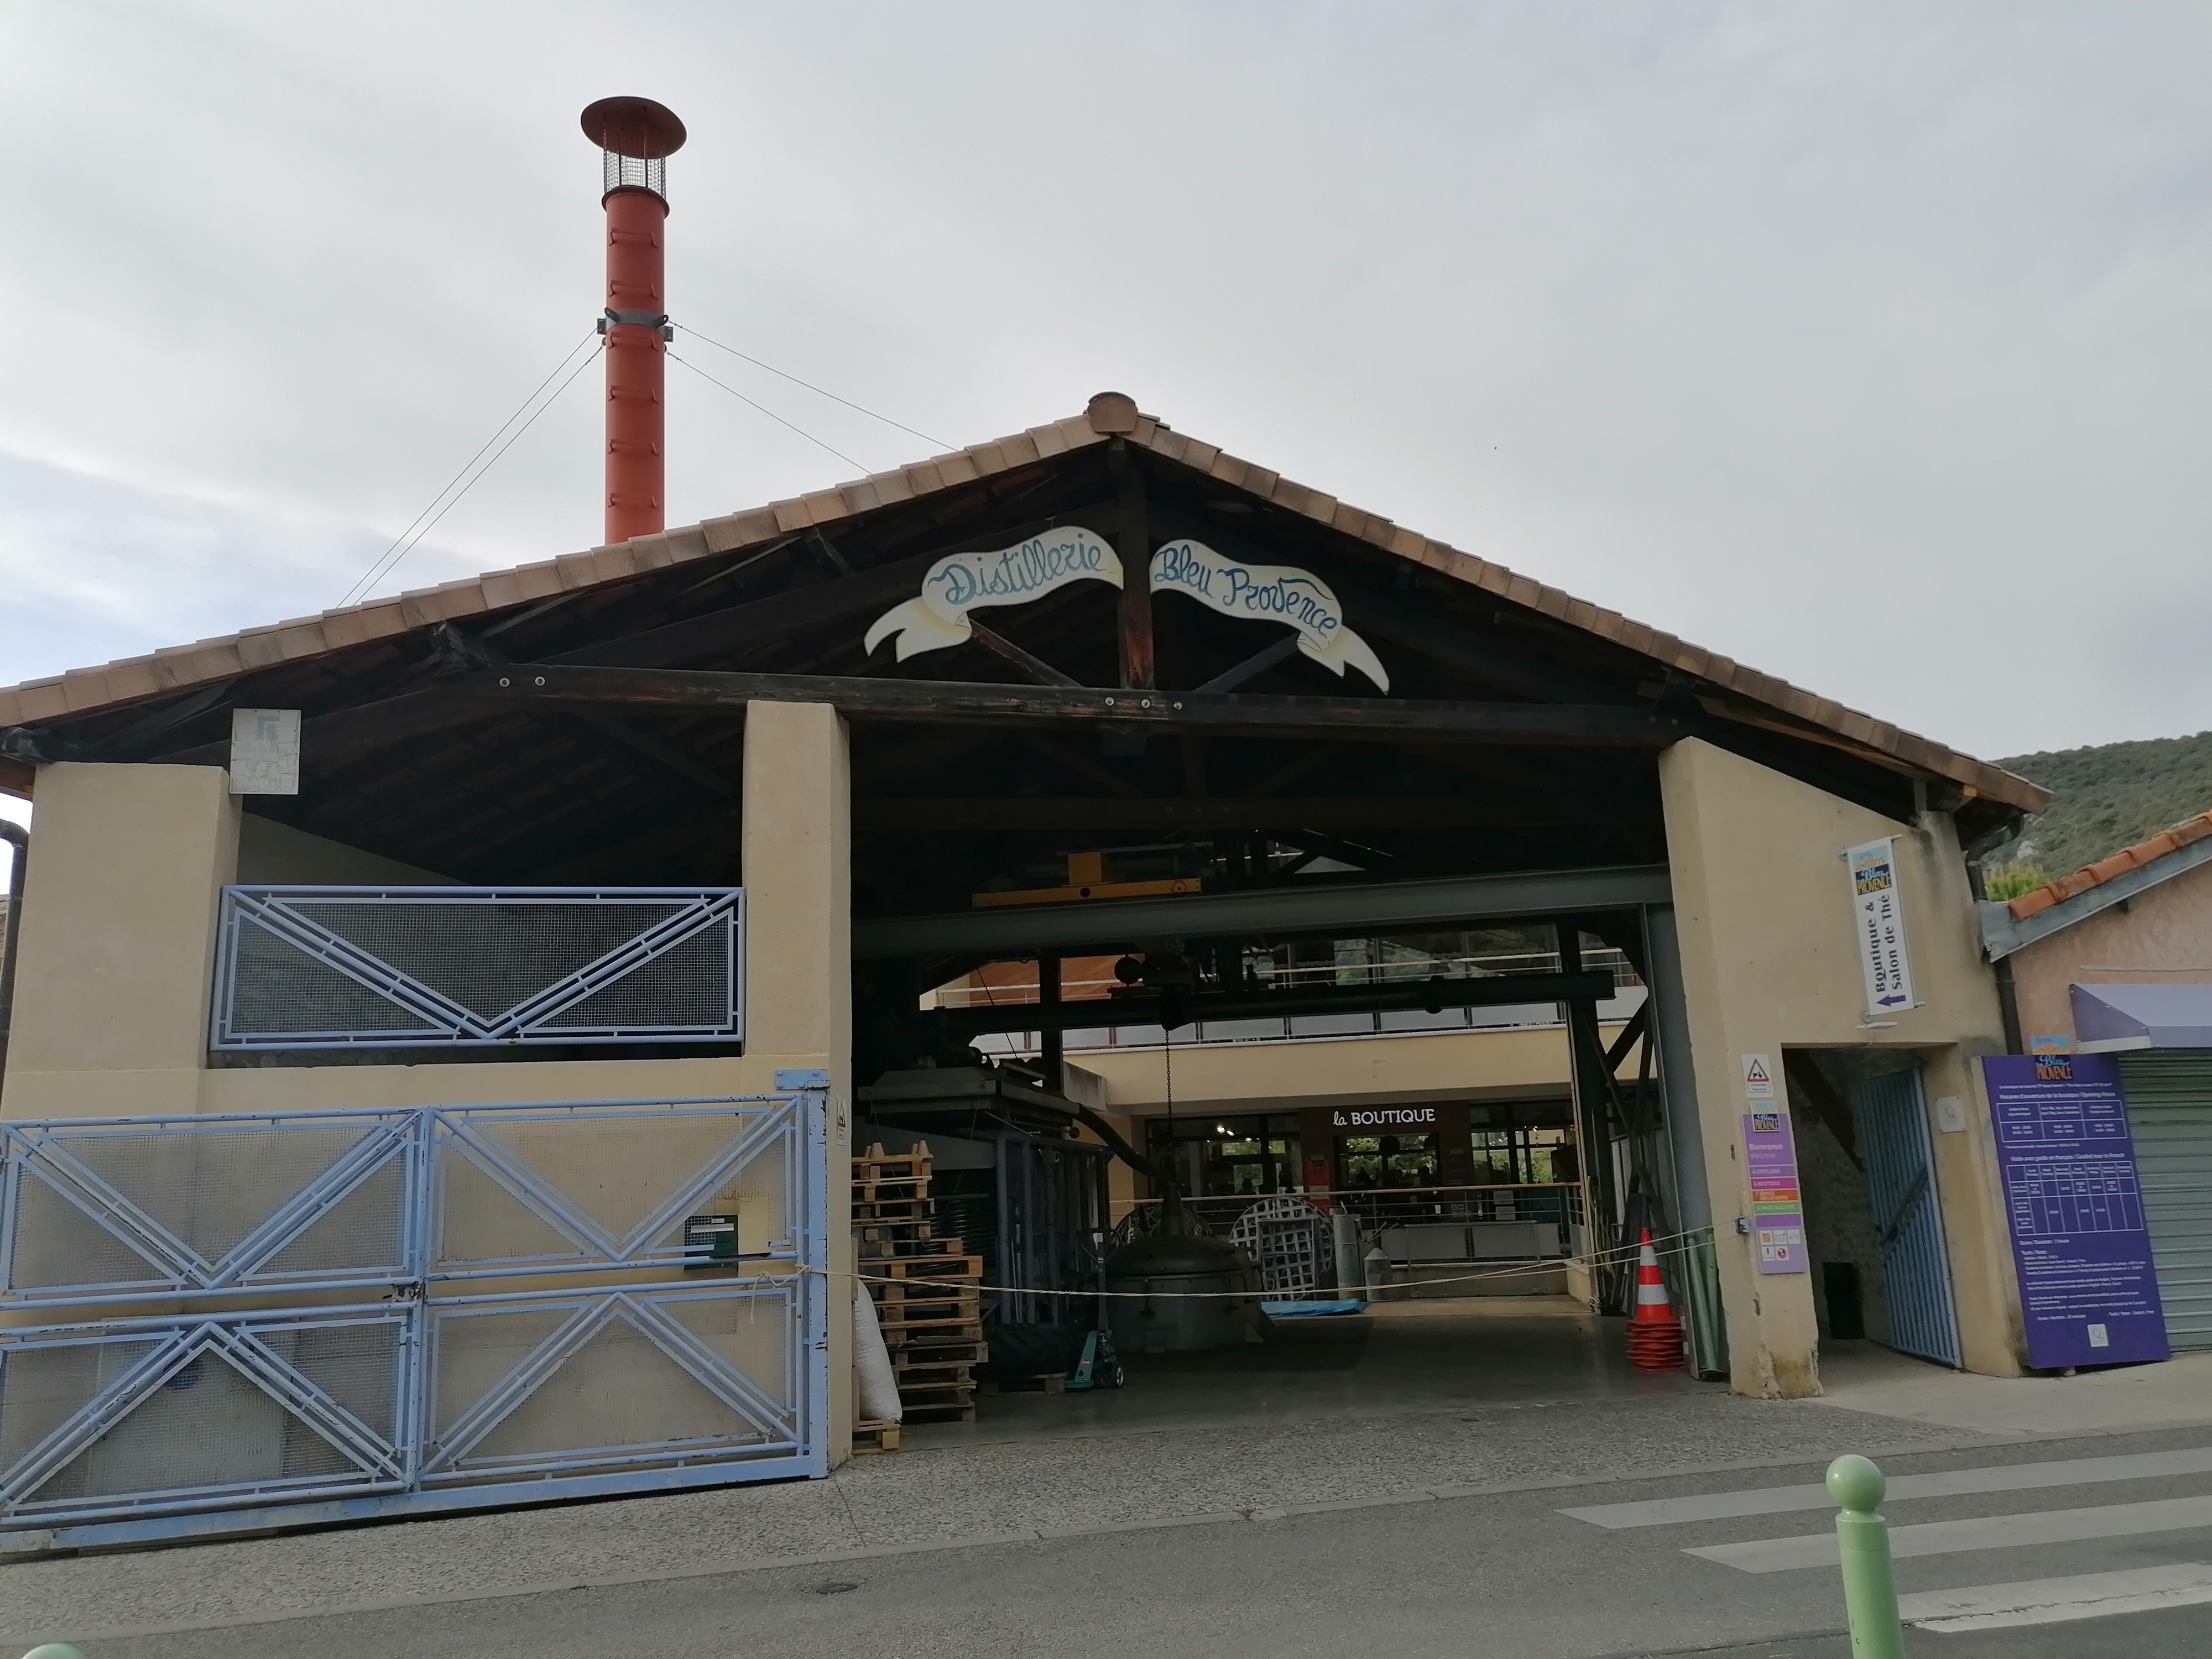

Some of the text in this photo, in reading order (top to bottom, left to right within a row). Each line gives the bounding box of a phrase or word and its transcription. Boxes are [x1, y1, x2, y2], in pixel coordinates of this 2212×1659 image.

[928, 539, 1107, 604] Distillerie
[1155, 545, 1337, 639] Bleu Provence
[1865, 901, 1886, 993] Boutique &
[1879, 894, 1902, 989] Salon de Thé
[1333, 1109, 1436, 1126] la BOUTIQUE
